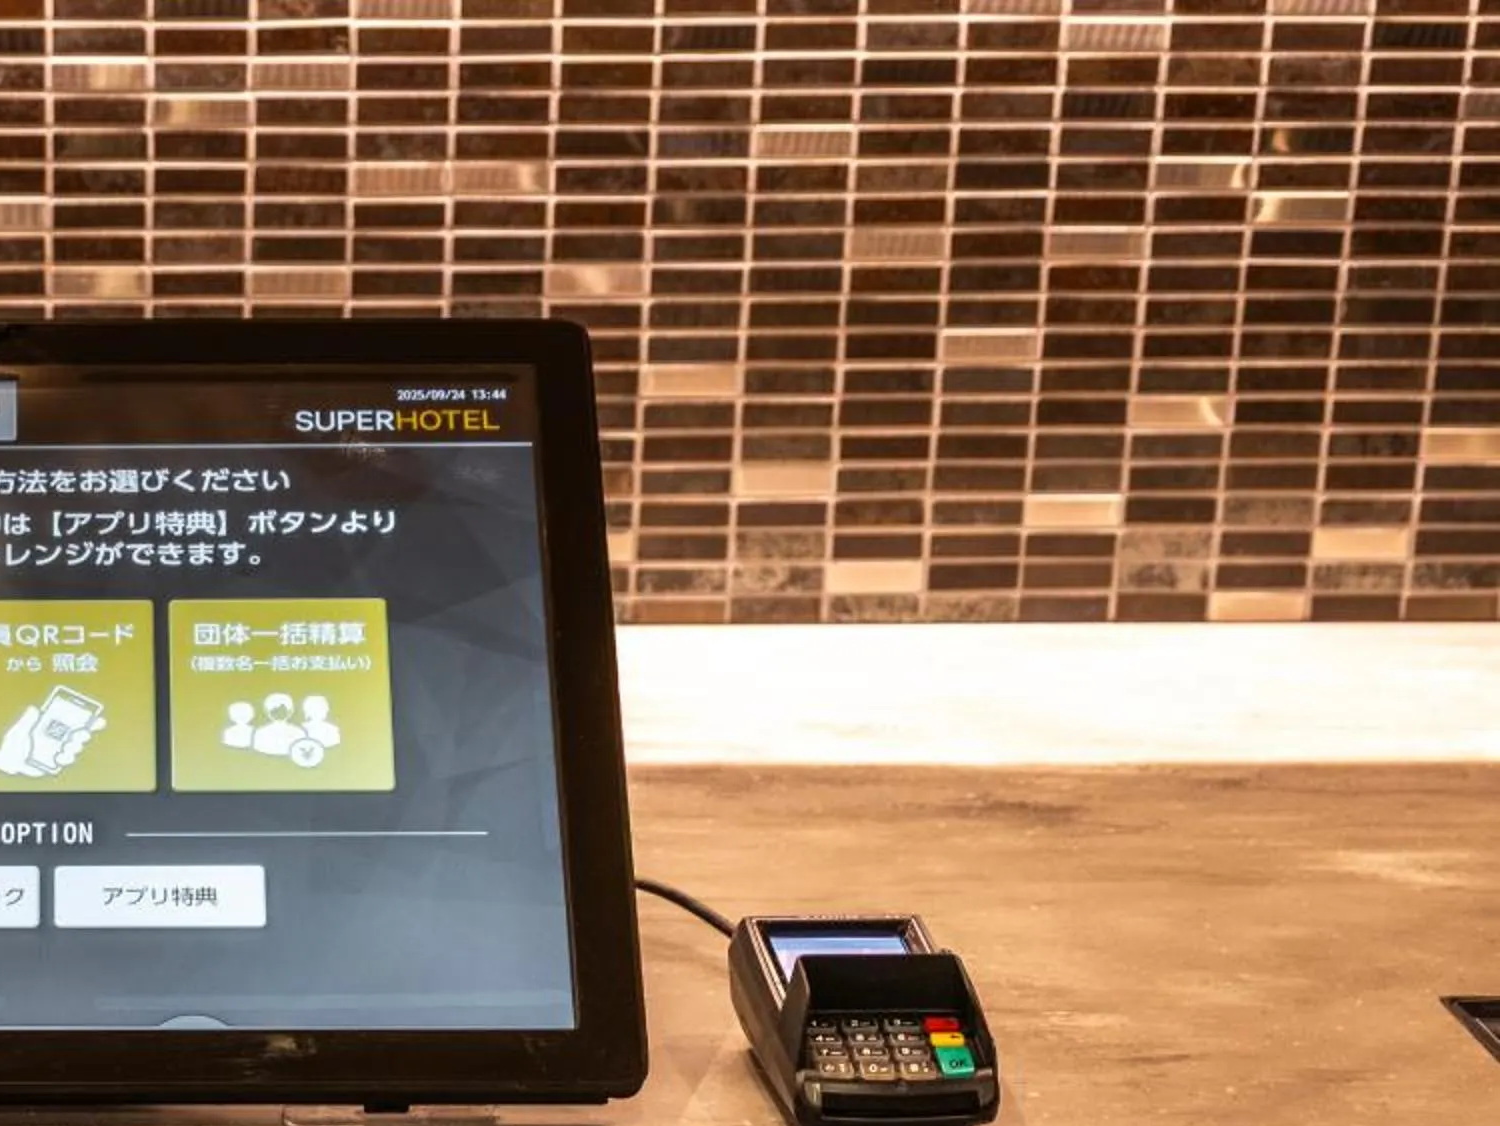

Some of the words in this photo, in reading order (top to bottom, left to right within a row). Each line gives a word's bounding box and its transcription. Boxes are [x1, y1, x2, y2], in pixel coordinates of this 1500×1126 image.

[472, 389, 507, 400] 13:44
[193, 621, 367, 647] 団体一括精算
[0, 820, 94, 846] OPTION
[102, 885, 219, 908] アプリ特典
